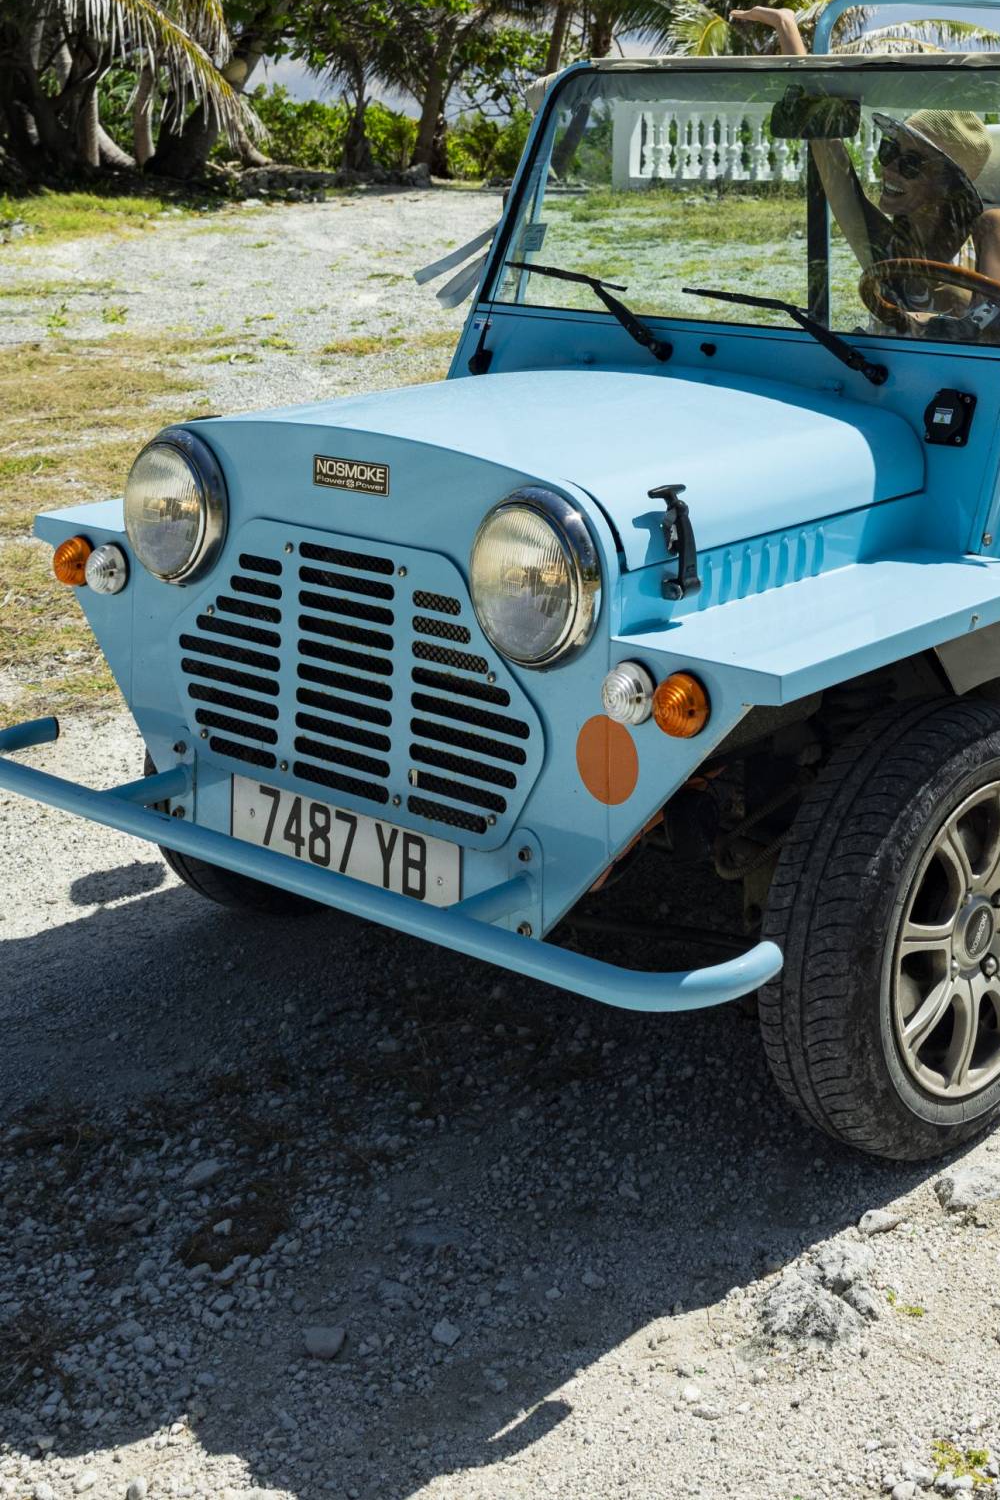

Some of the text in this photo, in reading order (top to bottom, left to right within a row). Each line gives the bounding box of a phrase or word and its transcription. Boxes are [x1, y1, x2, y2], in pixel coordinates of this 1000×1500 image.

[316, 459, 385, 483] NOSMOKE
[316, 474, 384, 491] Flower Power
[259, 785, 426, 900] 7487 YB
